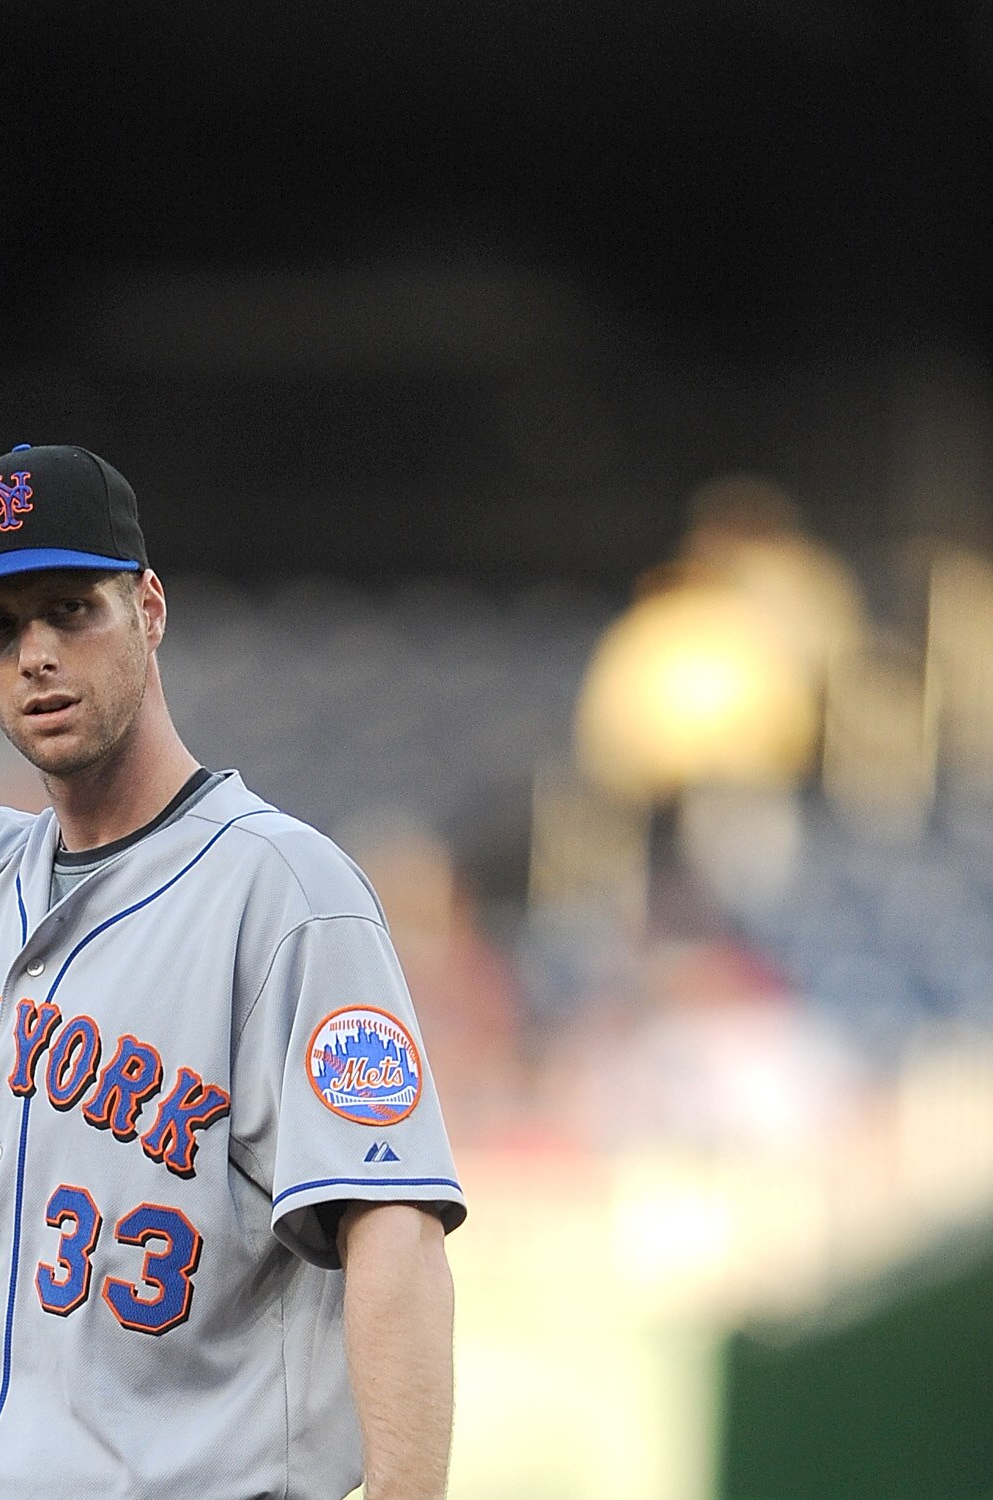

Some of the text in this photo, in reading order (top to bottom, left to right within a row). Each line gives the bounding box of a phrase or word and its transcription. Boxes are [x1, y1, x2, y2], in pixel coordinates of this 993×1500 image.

[8, 998, 231, 1180] YORK
[330, 1056, 404, 1092] Mets
[34, 1184, 204, 1337] 33
